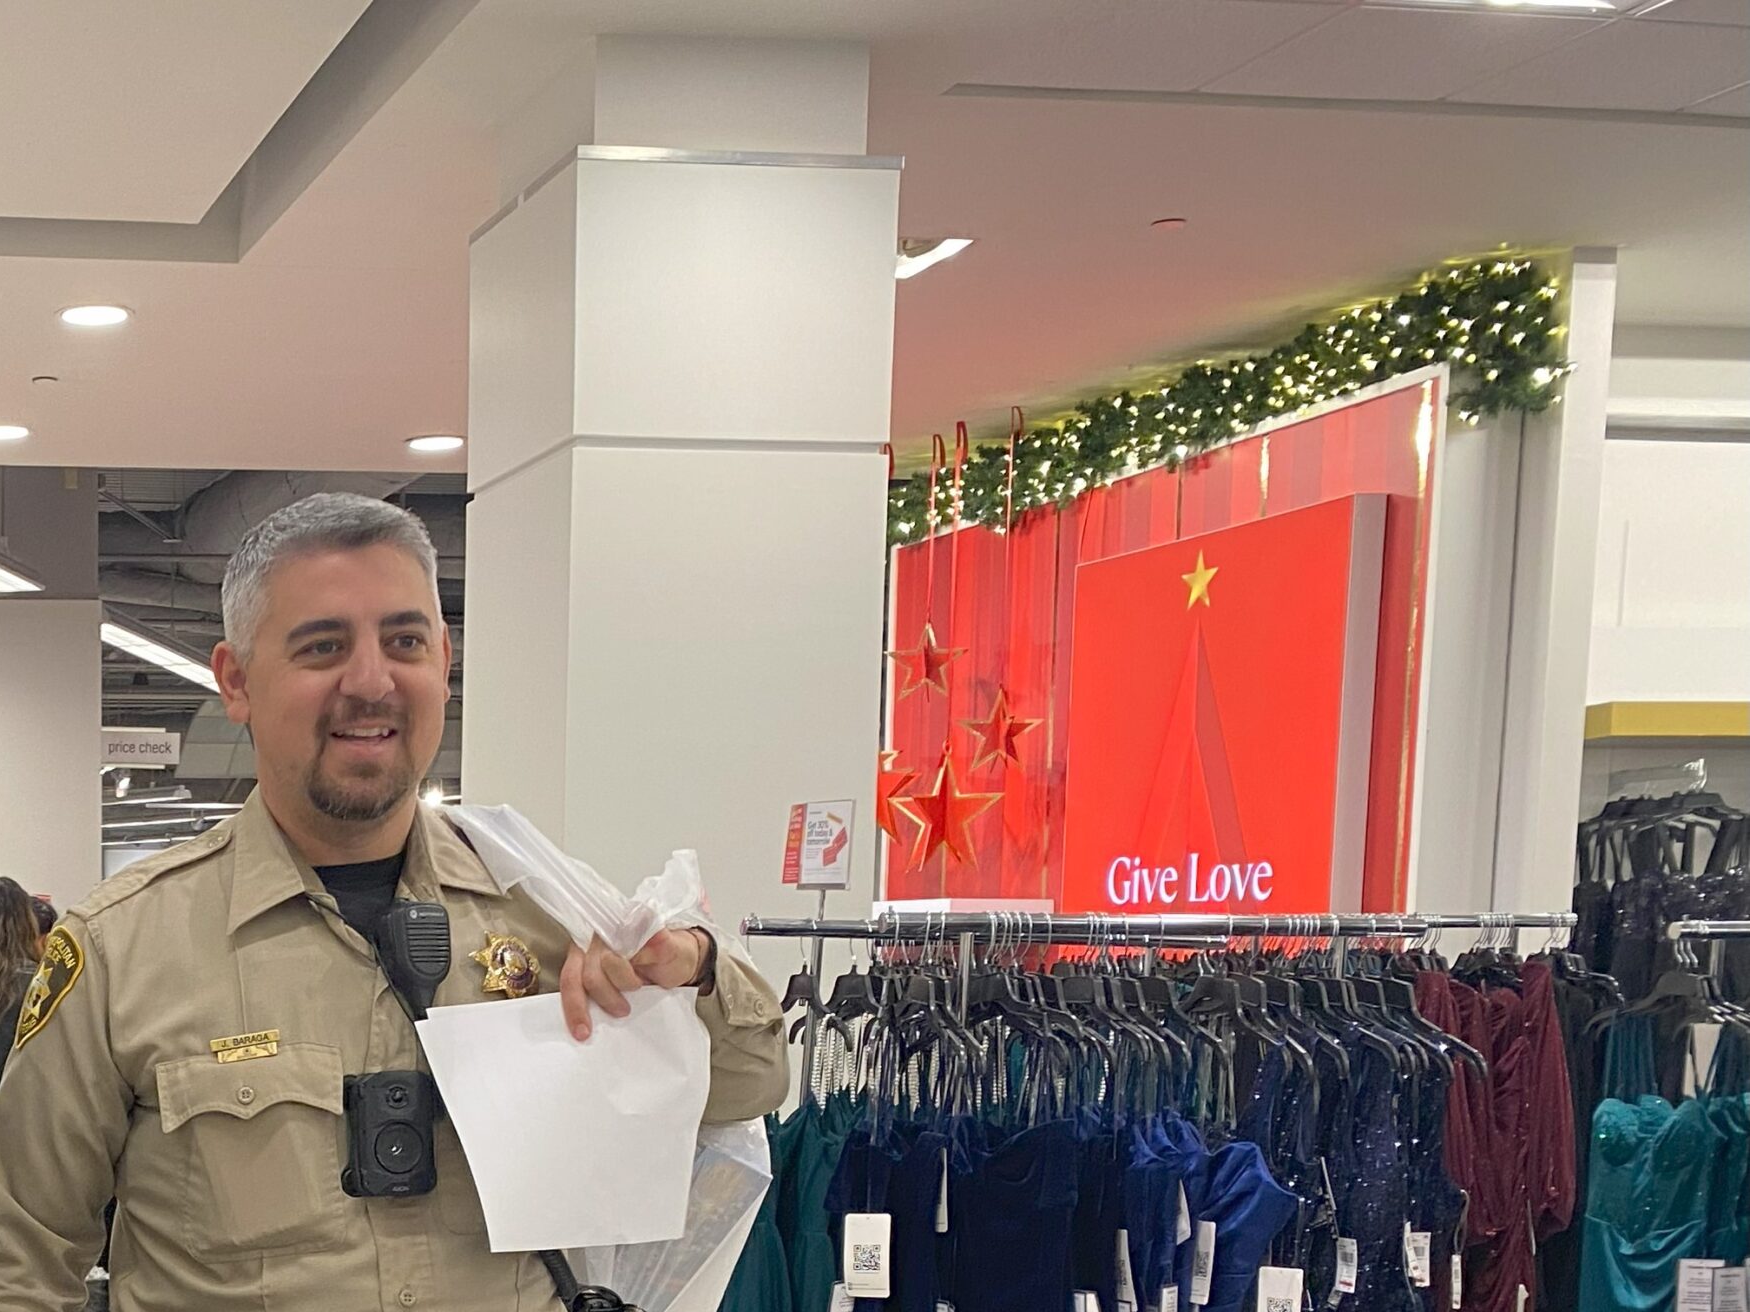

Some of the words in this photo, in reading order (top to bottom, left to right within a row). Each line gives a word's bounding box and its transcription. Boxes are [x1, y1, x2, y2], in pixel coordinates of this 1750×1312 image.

[108, 743, 136, 755] price
[139, 741, 172, 754] check
[1107, 856, 1178, 905] Give
[1189, 853, 1274, 903] Love
[221, 1040, 229, 1048] J.
